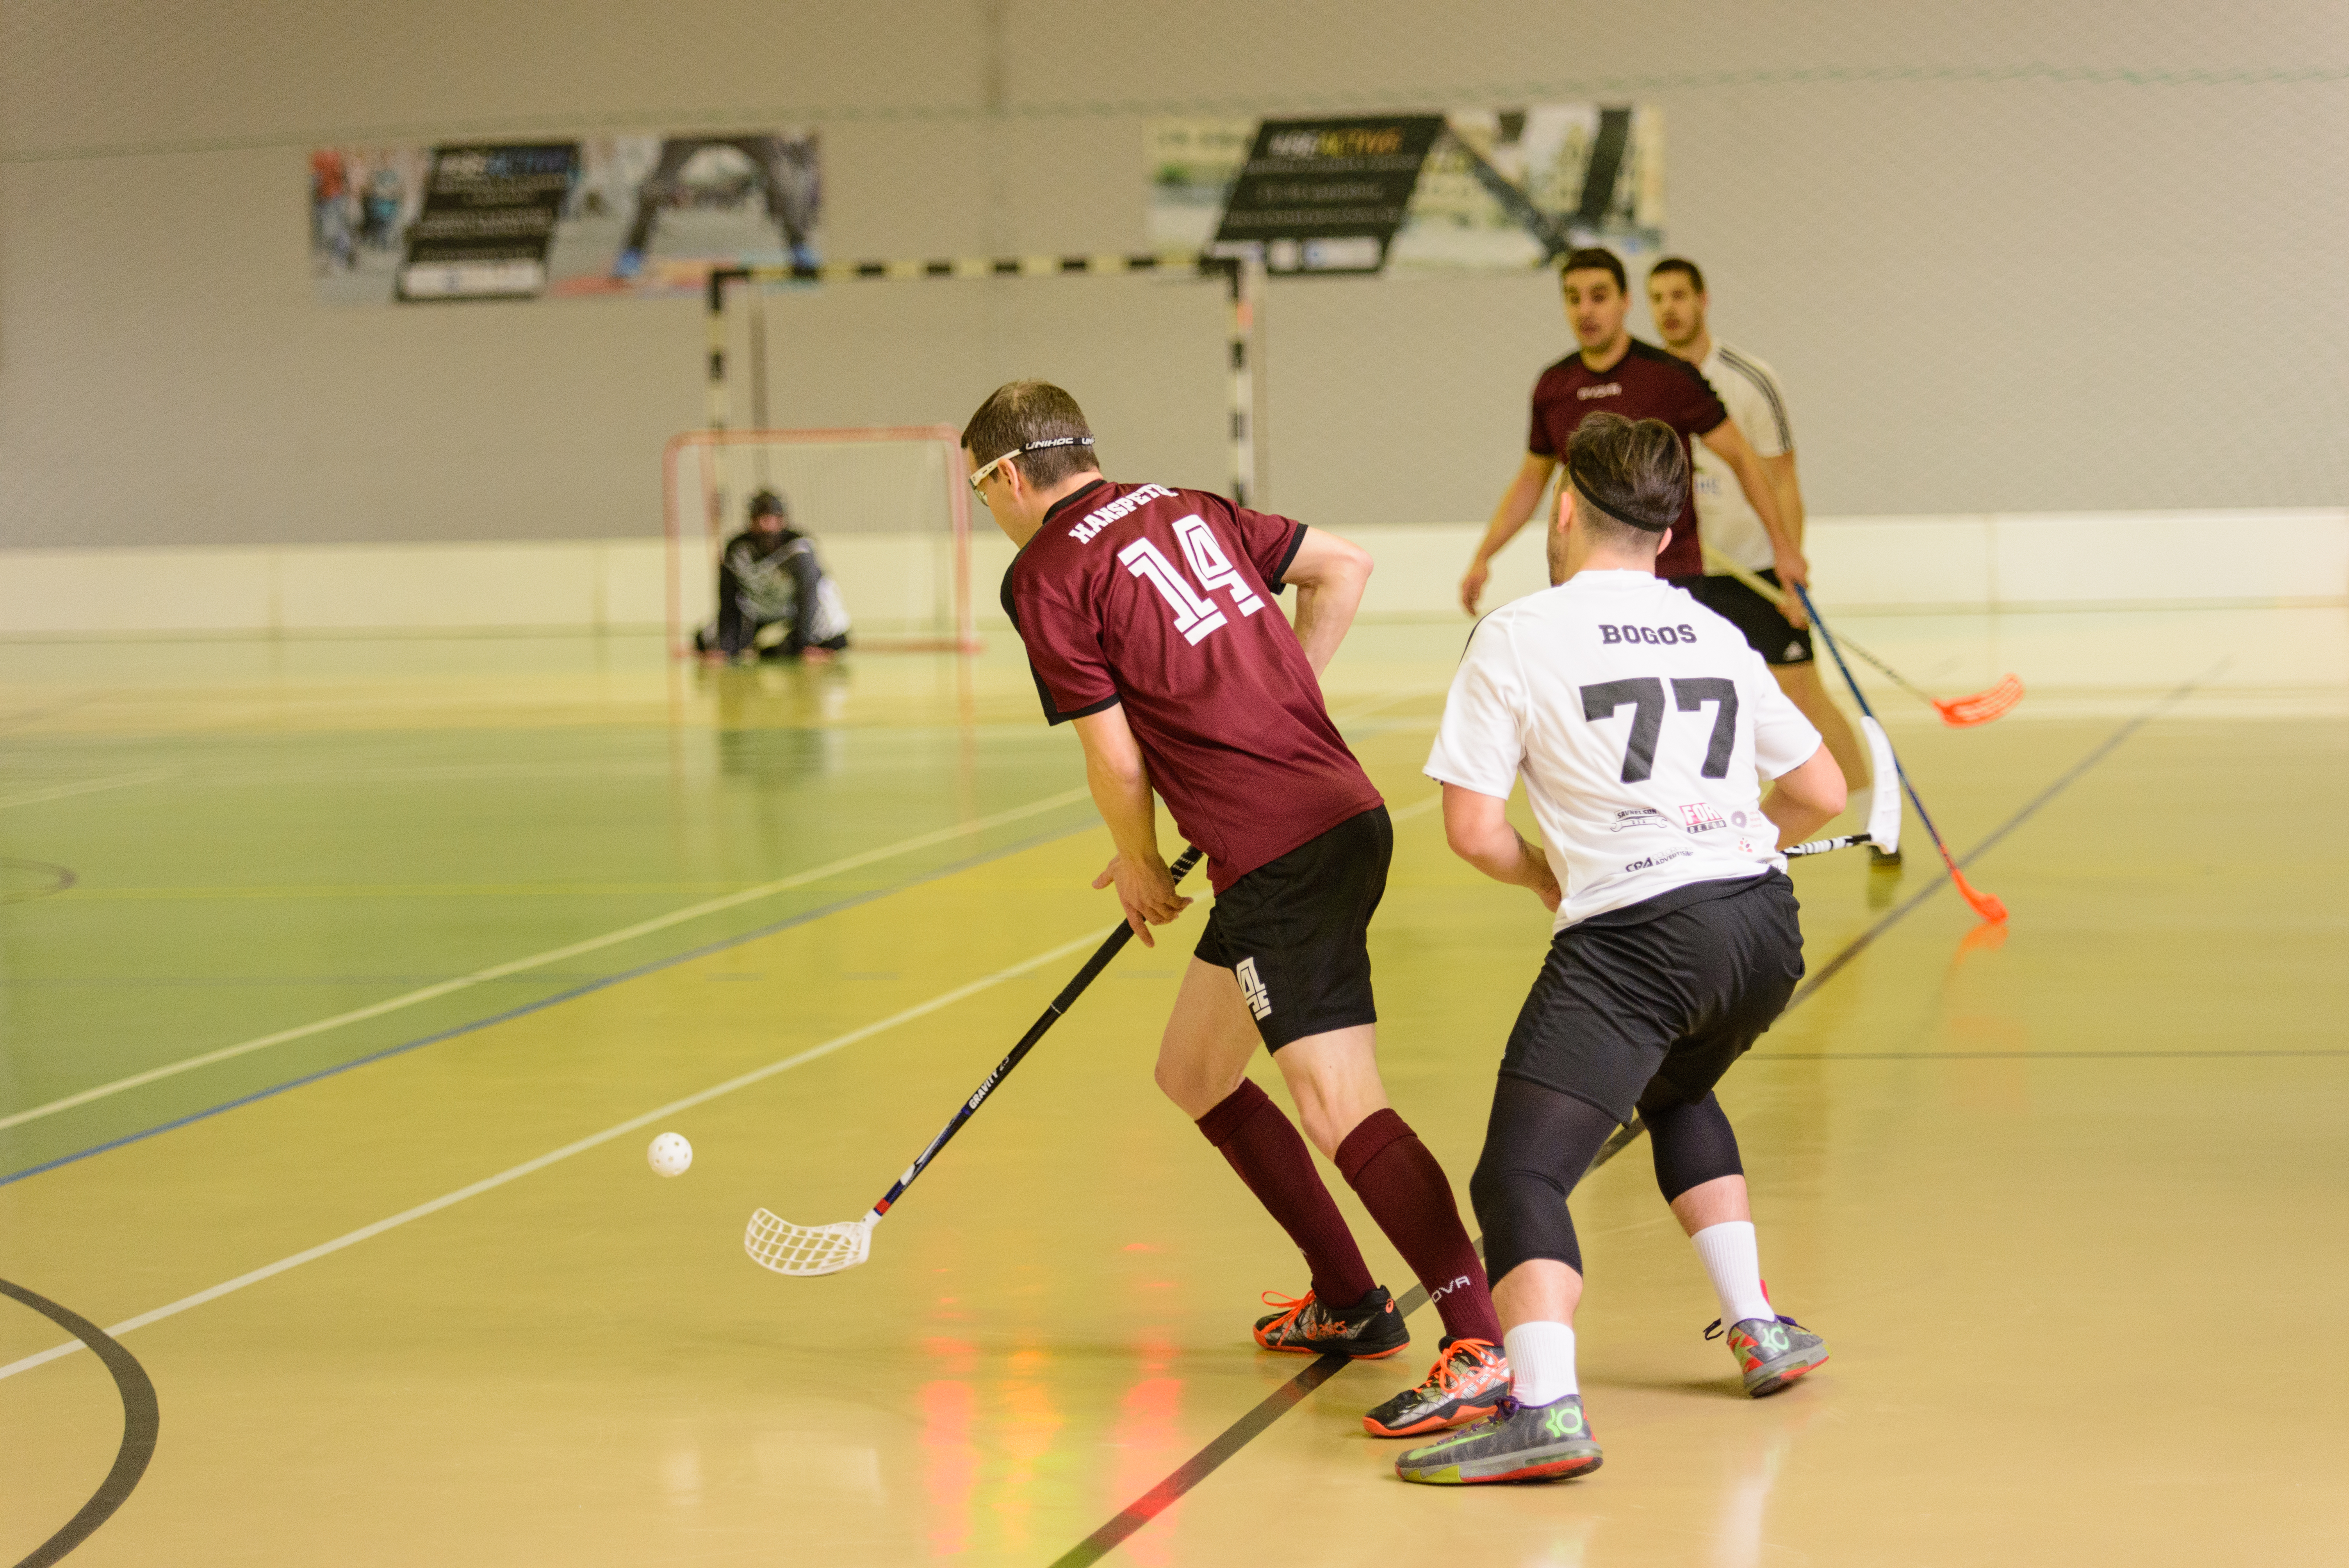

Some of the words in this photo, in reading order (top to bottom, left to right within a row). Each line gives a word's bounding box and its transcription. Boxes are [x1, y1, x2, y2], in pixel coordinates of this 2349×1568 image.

[1025, 437, 1074, 450] UNIHOC
[1117, 514, 1265, 647] 14
[1598, 624, 1697, 645] BOGOS
[1579, 677, 1739, 784] 77
[1681, 803, 1719, 824] FOR
[1690, 821, 1725, 833] BETON
[968, 1069, 998, 1109] GRAVITY
